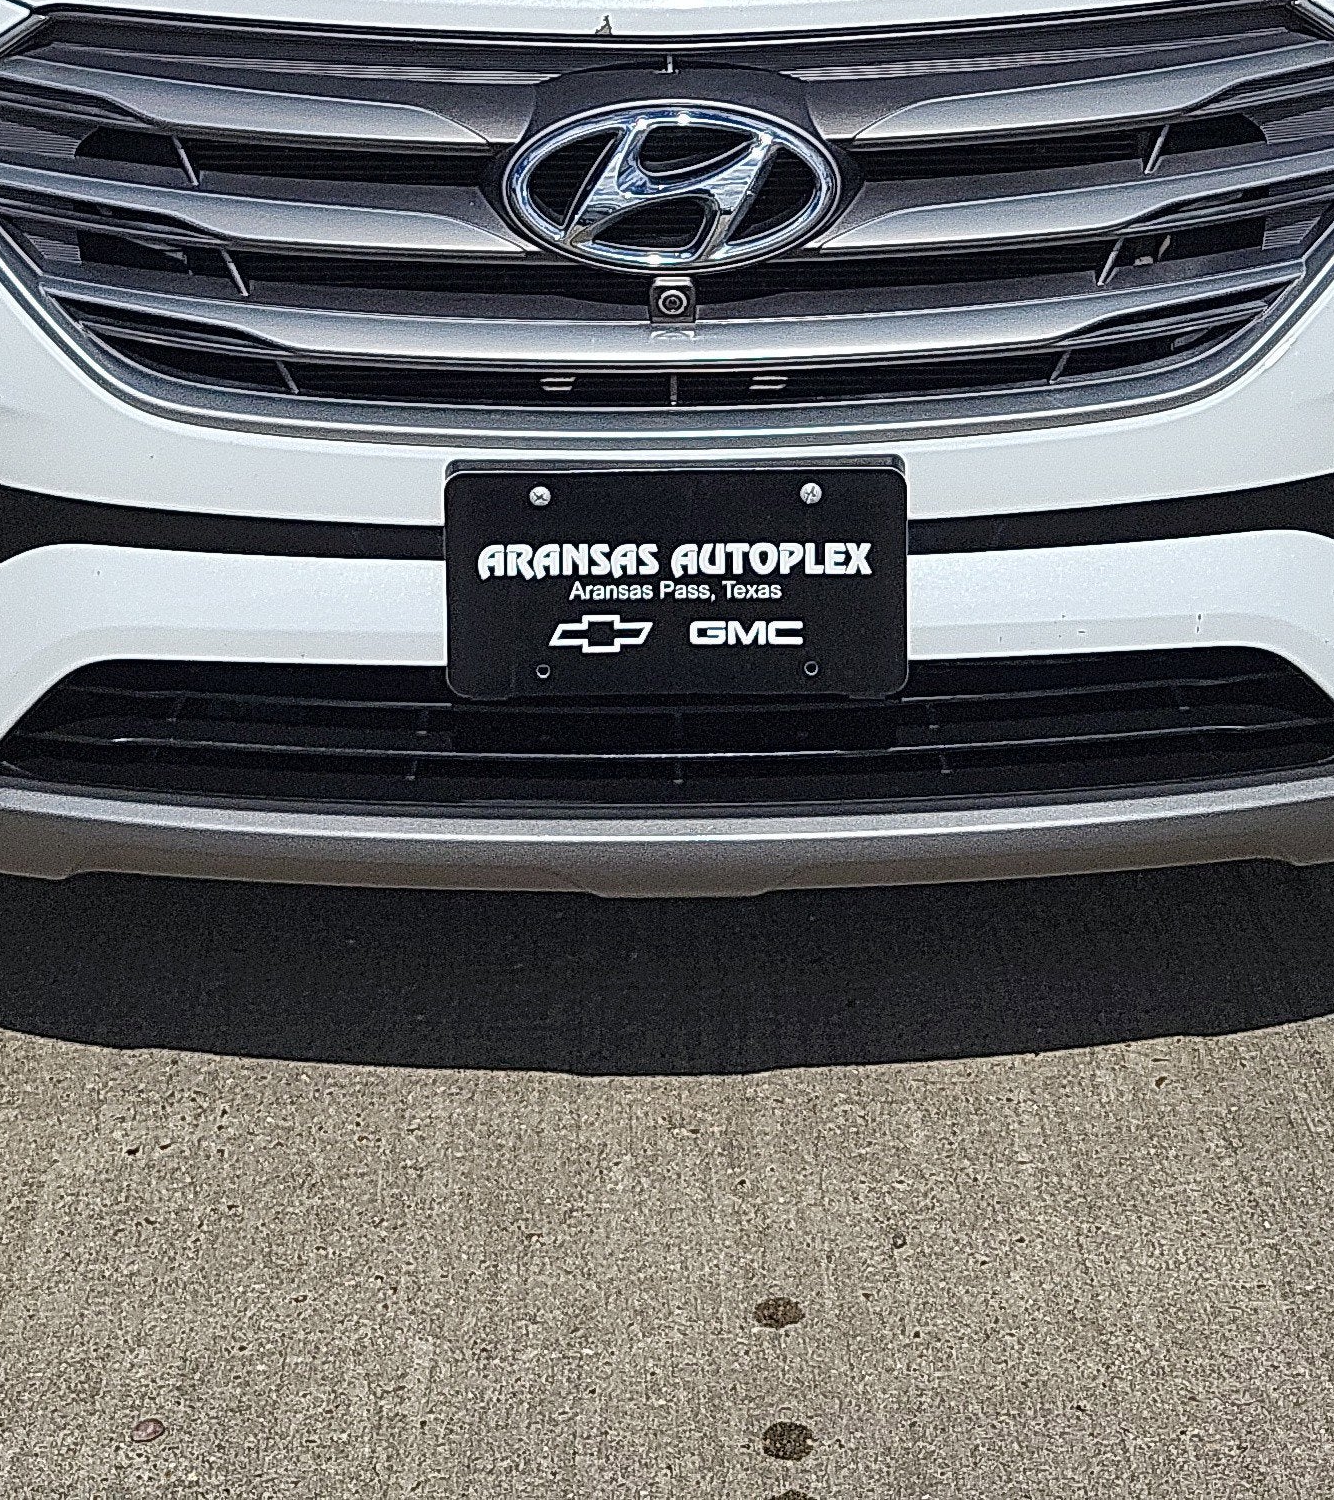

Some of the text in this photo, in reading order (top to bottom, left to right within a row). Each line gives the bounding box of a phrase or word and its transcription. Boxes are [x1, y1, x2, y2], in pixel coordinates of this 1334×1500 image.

[477, 542, 872, 581] ARANSAS AUTOPLEX
[569, 581, 782, 601] Aransas Pass, Texas
[689, 620, 804, 646] GMC
